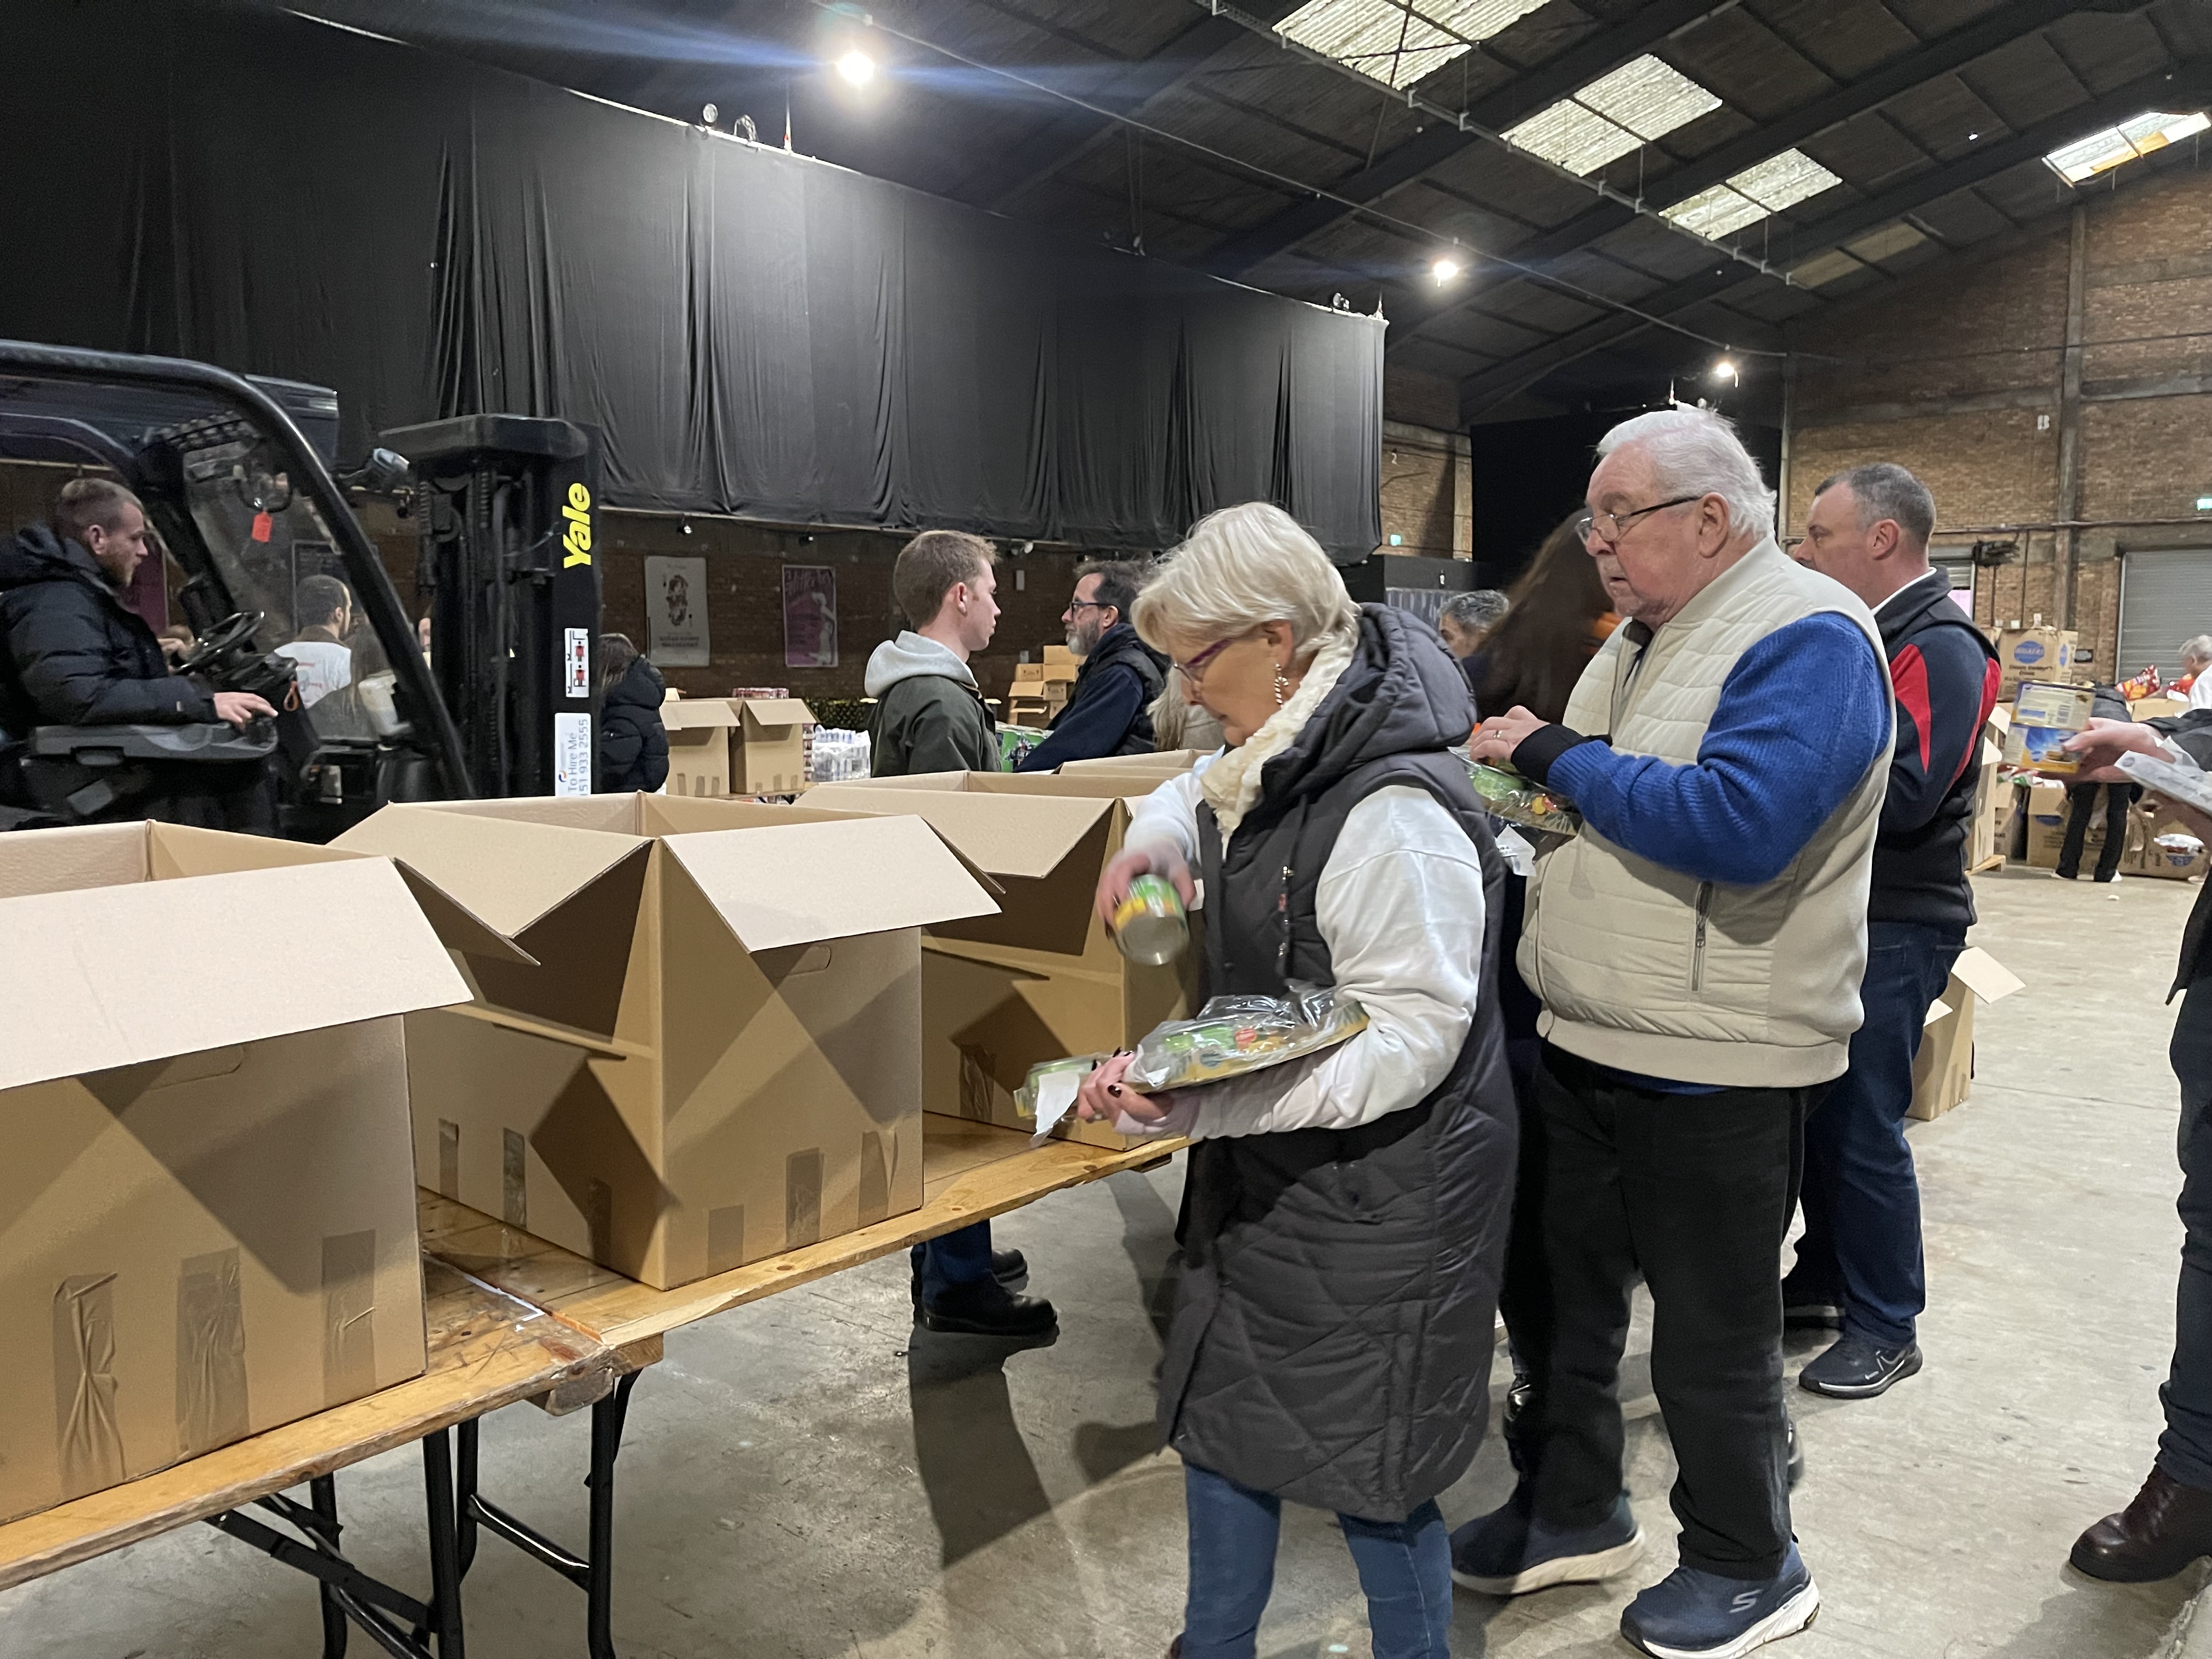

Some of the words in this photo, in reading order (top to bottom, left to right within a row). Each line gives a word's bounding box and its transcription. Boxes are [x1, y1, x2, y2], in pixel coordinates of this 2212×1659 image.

[562, 483, 591, 569] Yale
[568, 733, 577, 749] Me
[579, 719, 588, 748] 2555
[568, 754, 577, 775] Hire
[579, 752, 588, 774] 933
[568, 778, 577, 791] To
